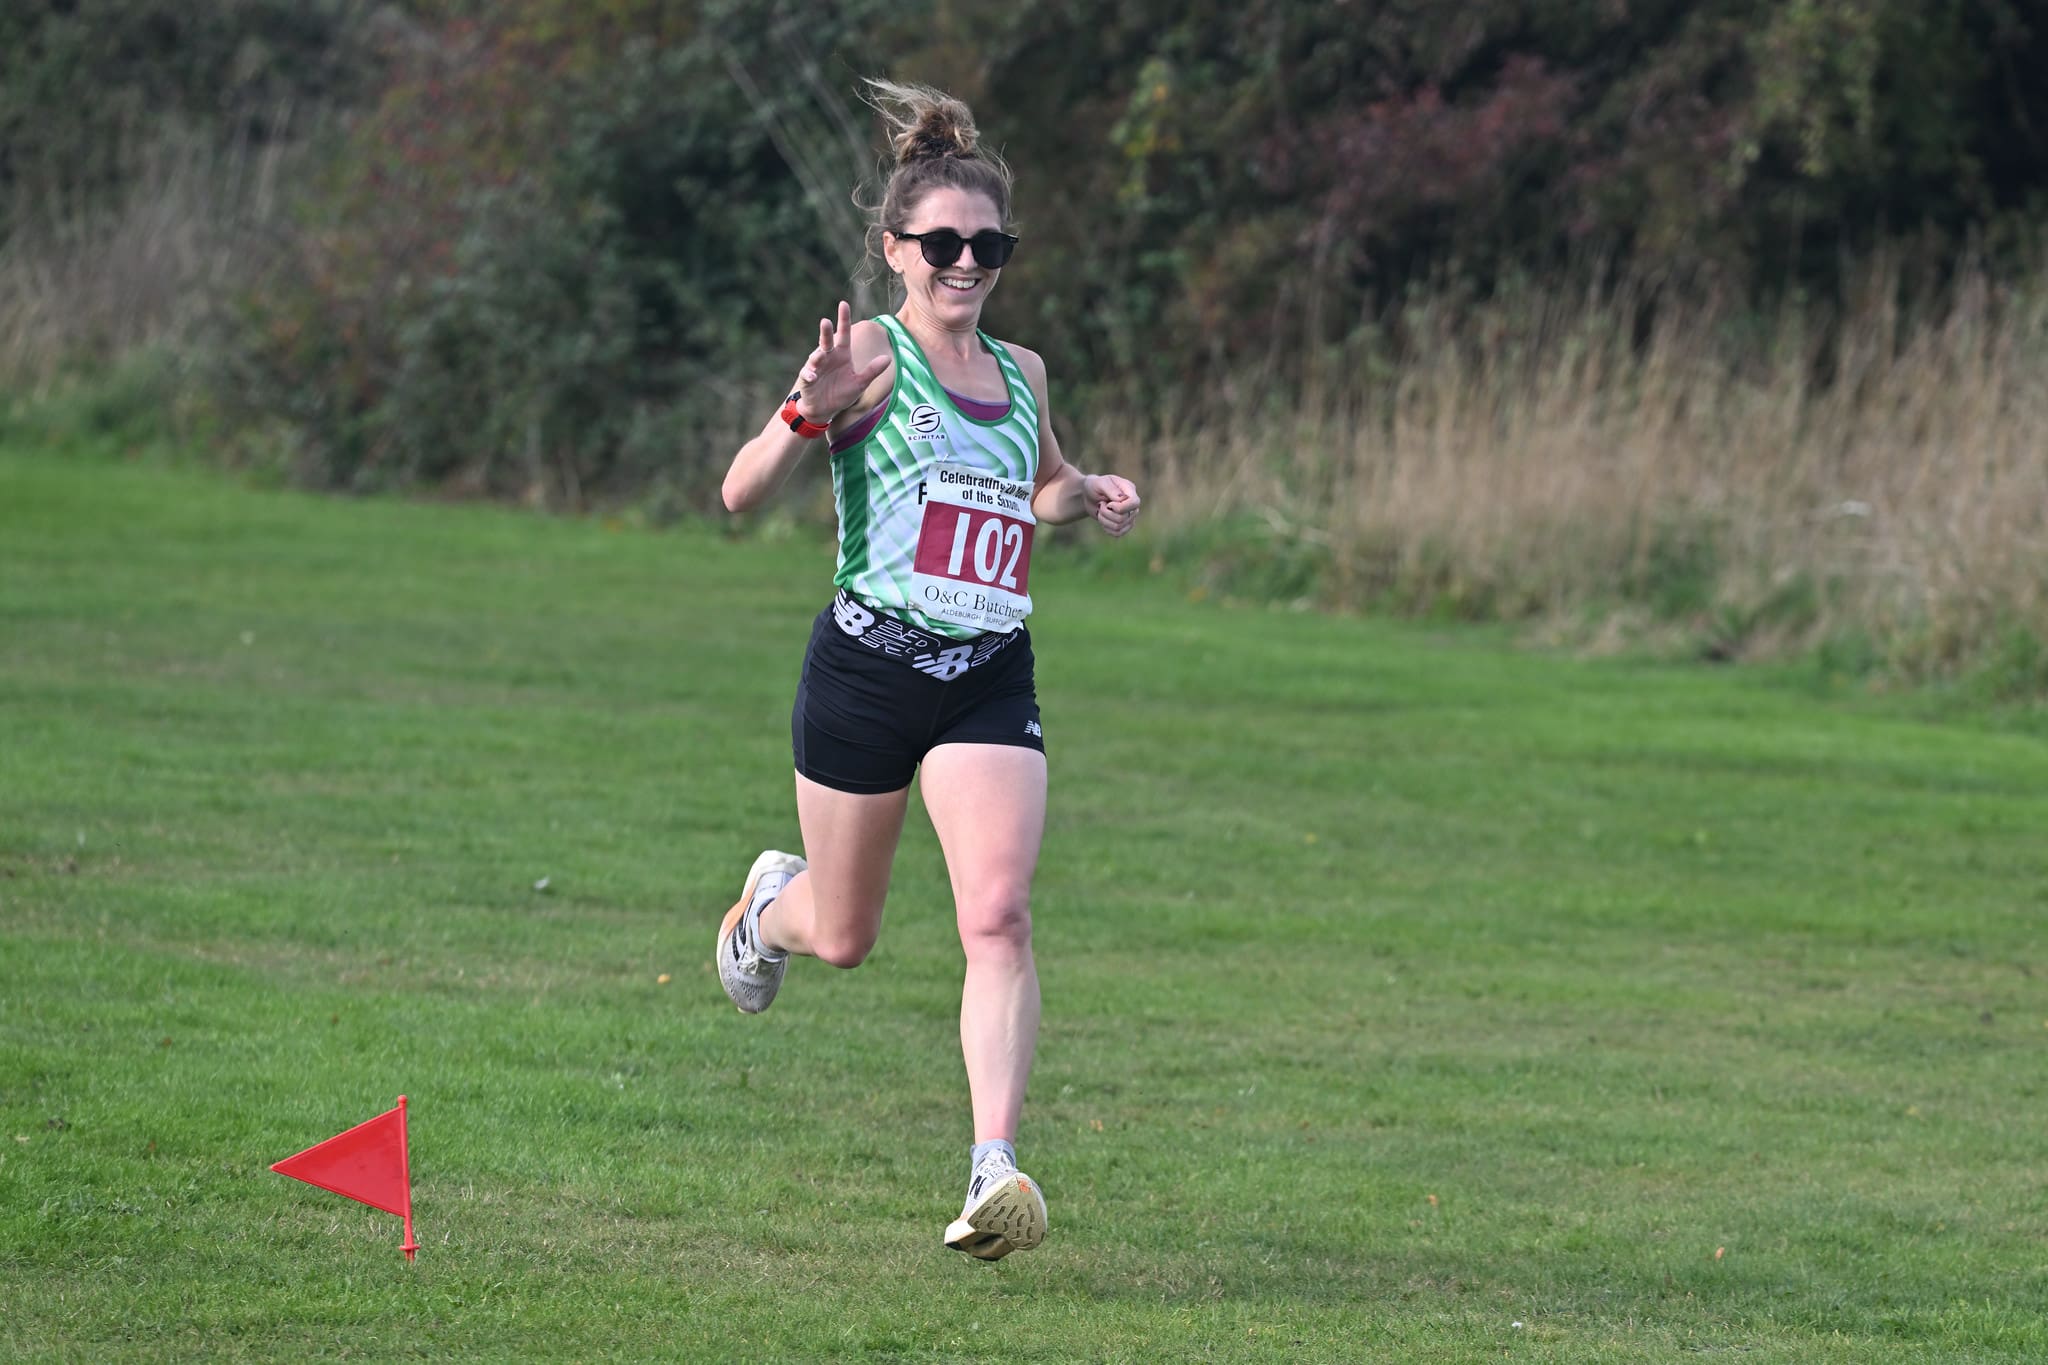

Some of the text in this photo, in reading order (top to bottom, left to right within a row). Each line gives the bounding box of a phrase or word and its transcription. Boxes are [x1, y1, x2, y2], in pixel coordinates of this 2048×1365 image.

[962, 489, 973, 501] of
[976, 490, 993, 505] the
[947, 512, 1023, 589] 102
[924, 585, 968, 607] O&C
[941, 608, 981, 620] ALDEBURGH
